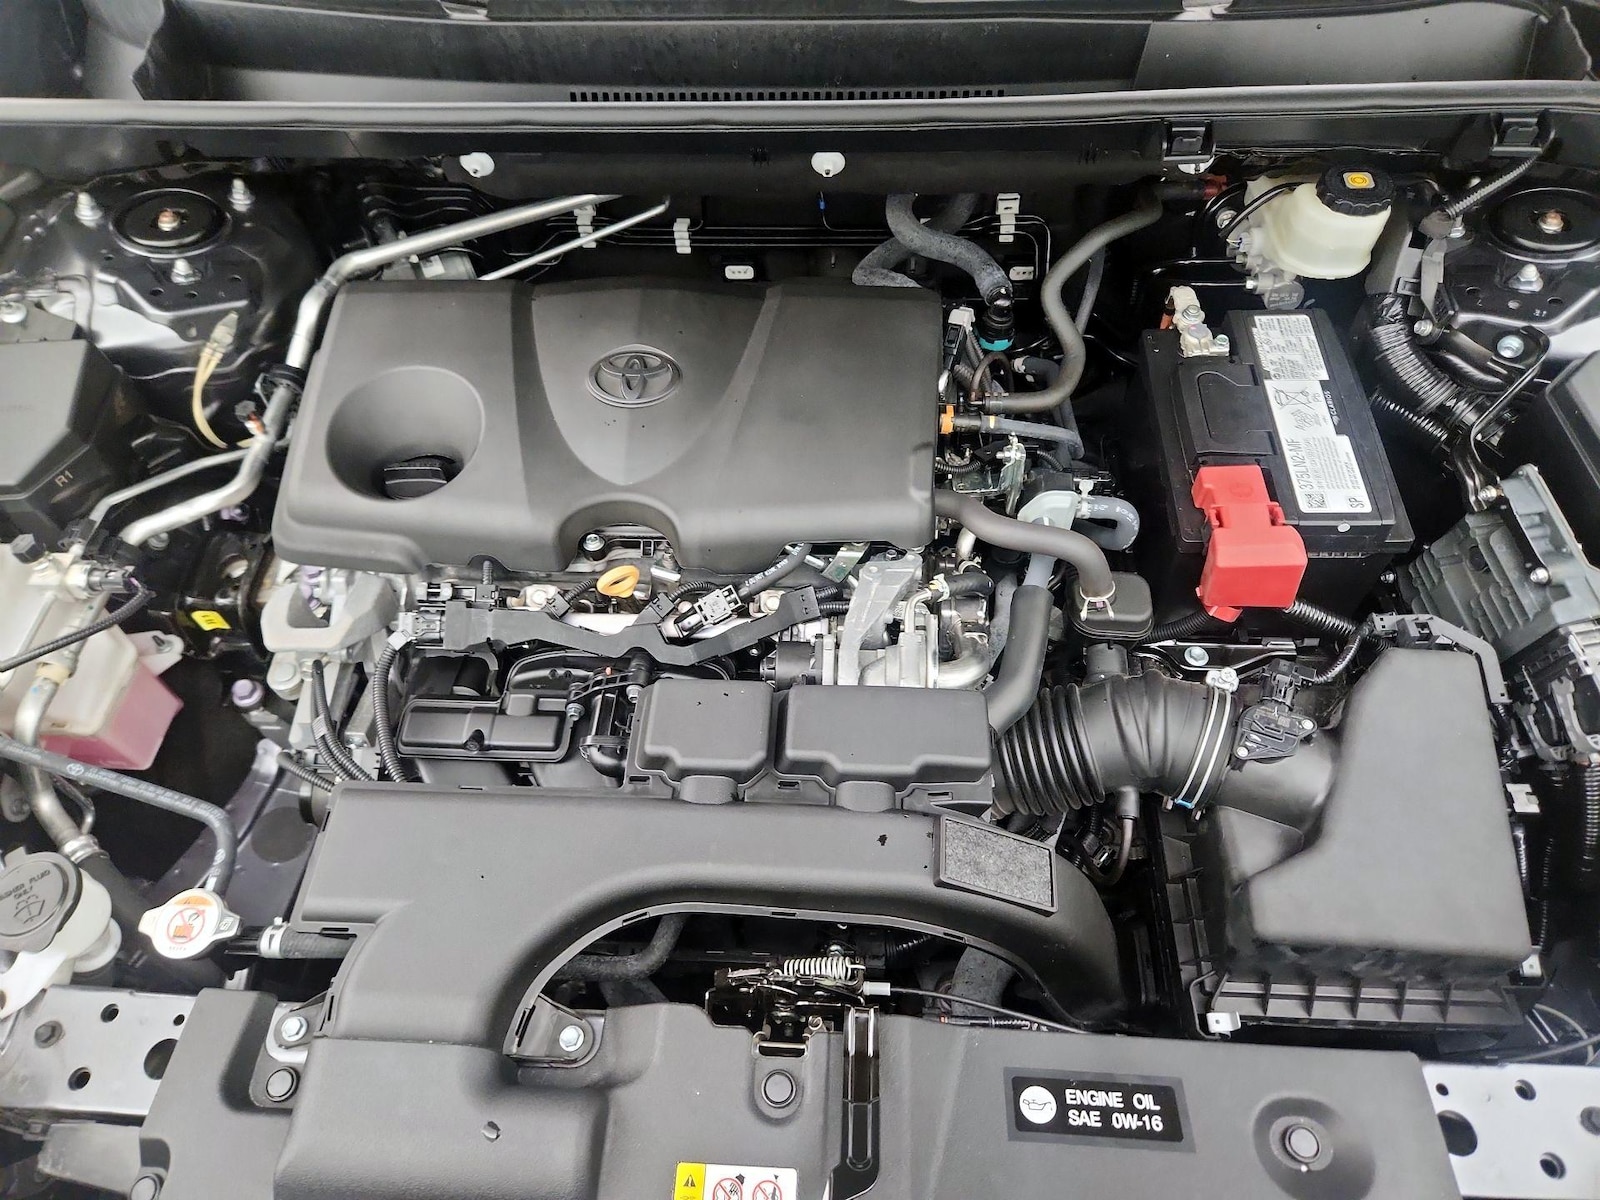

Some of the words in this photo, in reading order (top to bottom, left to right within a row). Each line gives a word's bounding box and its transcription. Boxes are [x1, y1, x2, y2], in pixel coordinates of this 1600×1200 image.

[1323, 390, 1338, 417] CLARIOS
[1285, 438, 1314, 490] 375LN2-MF
[55, 470, 74, 487] R1
[1348, 497, 1365, 509] SP
[29, 869, 51, 884] FLUID
[1065, 1088, 1125, 1108] ENGINE
[1132, 1093, 1162, 1111] OIL
[1067, 1109, 1103, 1127] SAE
[1111, 1112, 1164, 1132] 0W-16
